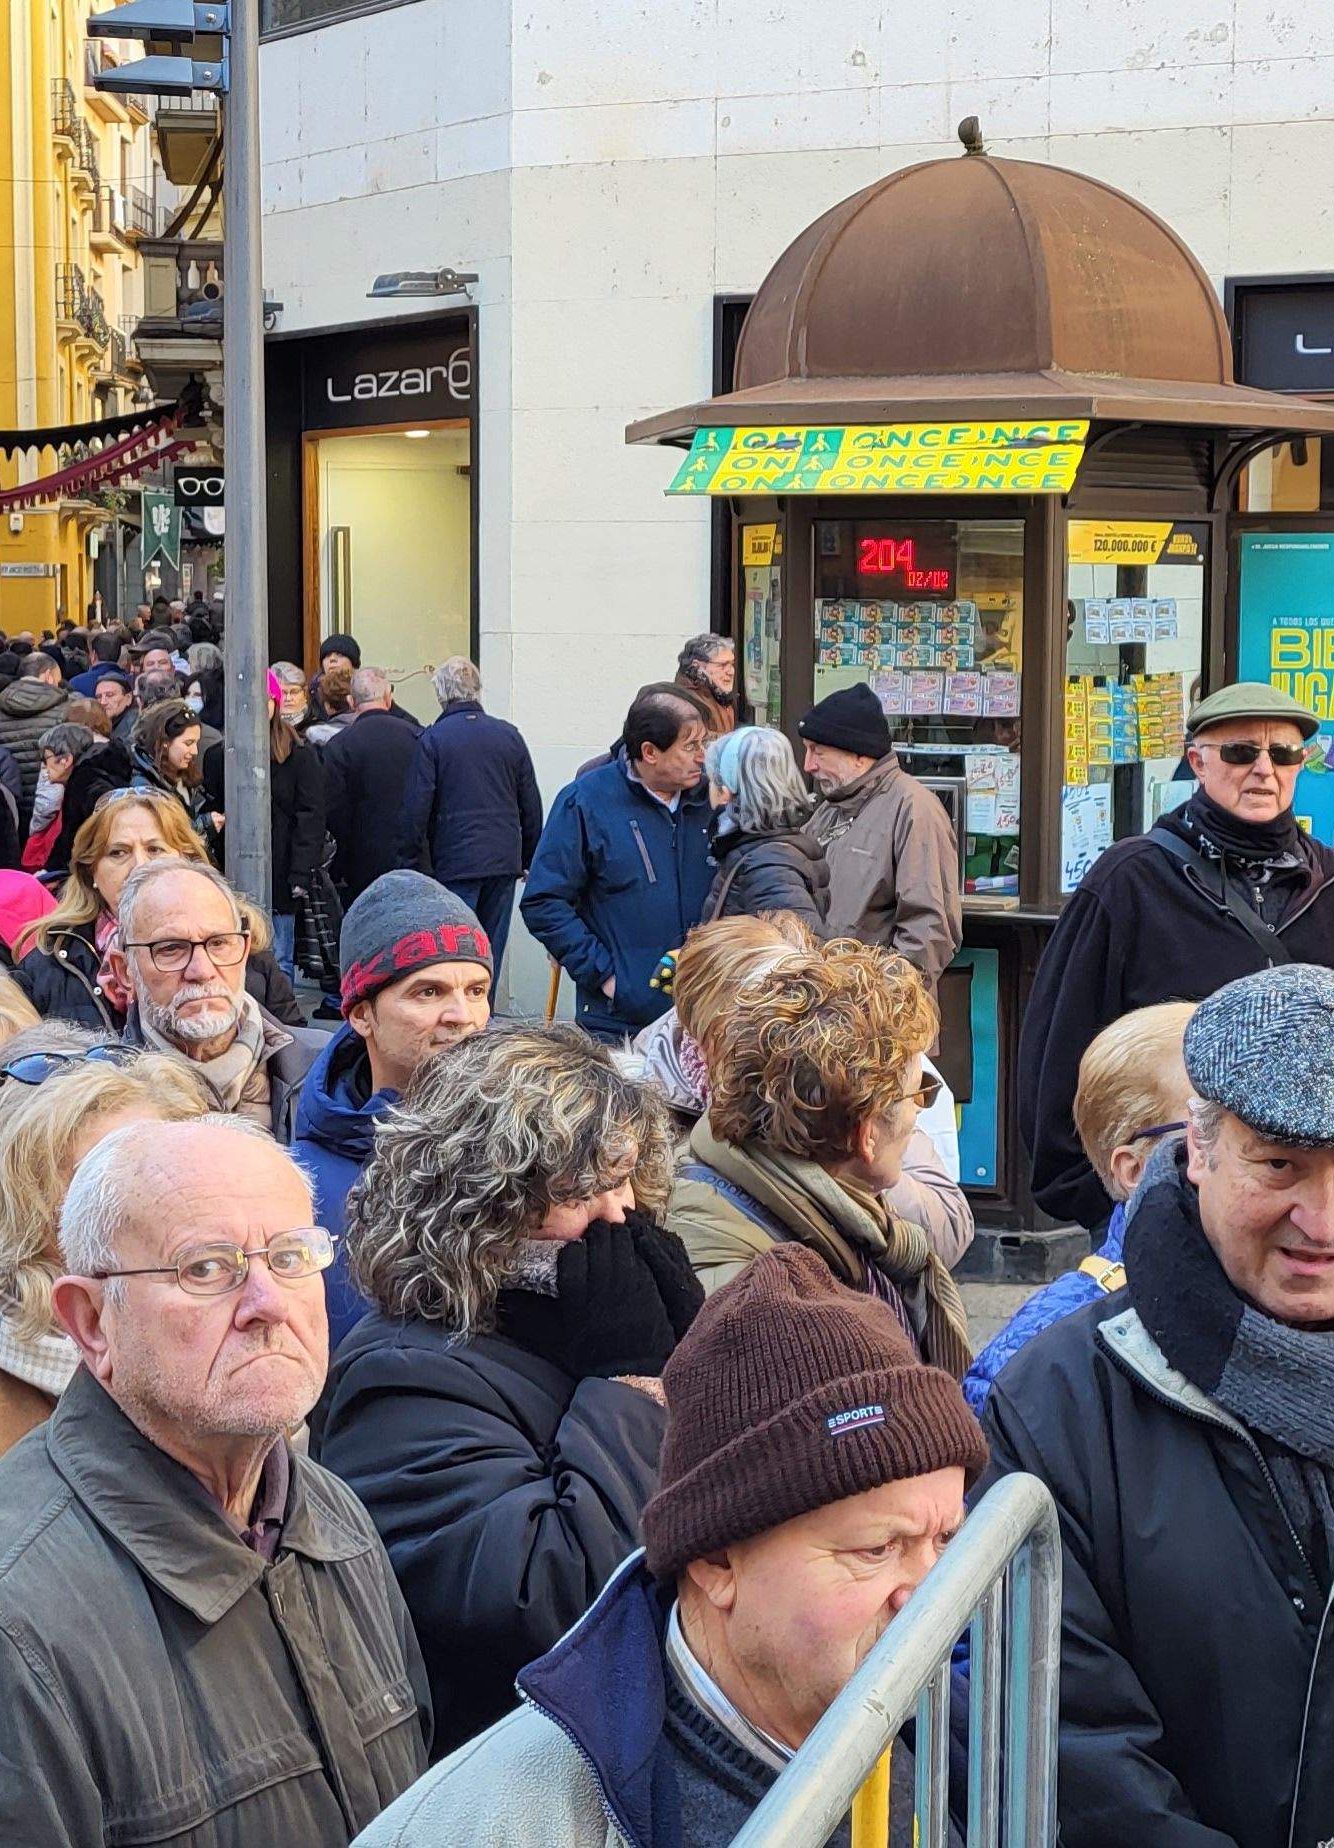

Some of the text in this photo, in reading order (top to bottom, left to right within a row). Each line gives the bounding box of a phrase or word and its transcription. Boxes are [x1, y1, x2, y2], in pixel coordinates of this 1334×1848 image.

[847, 453, 963, 468] ONCE
[972, 452, 1074, 467] NCE
[829, 474, 950, 488] ONCE
[1094, 539, 1148, 552] 120.000.000
[859, 539, 914, 572] 204
[907, 571, 949, 588] 02/02
